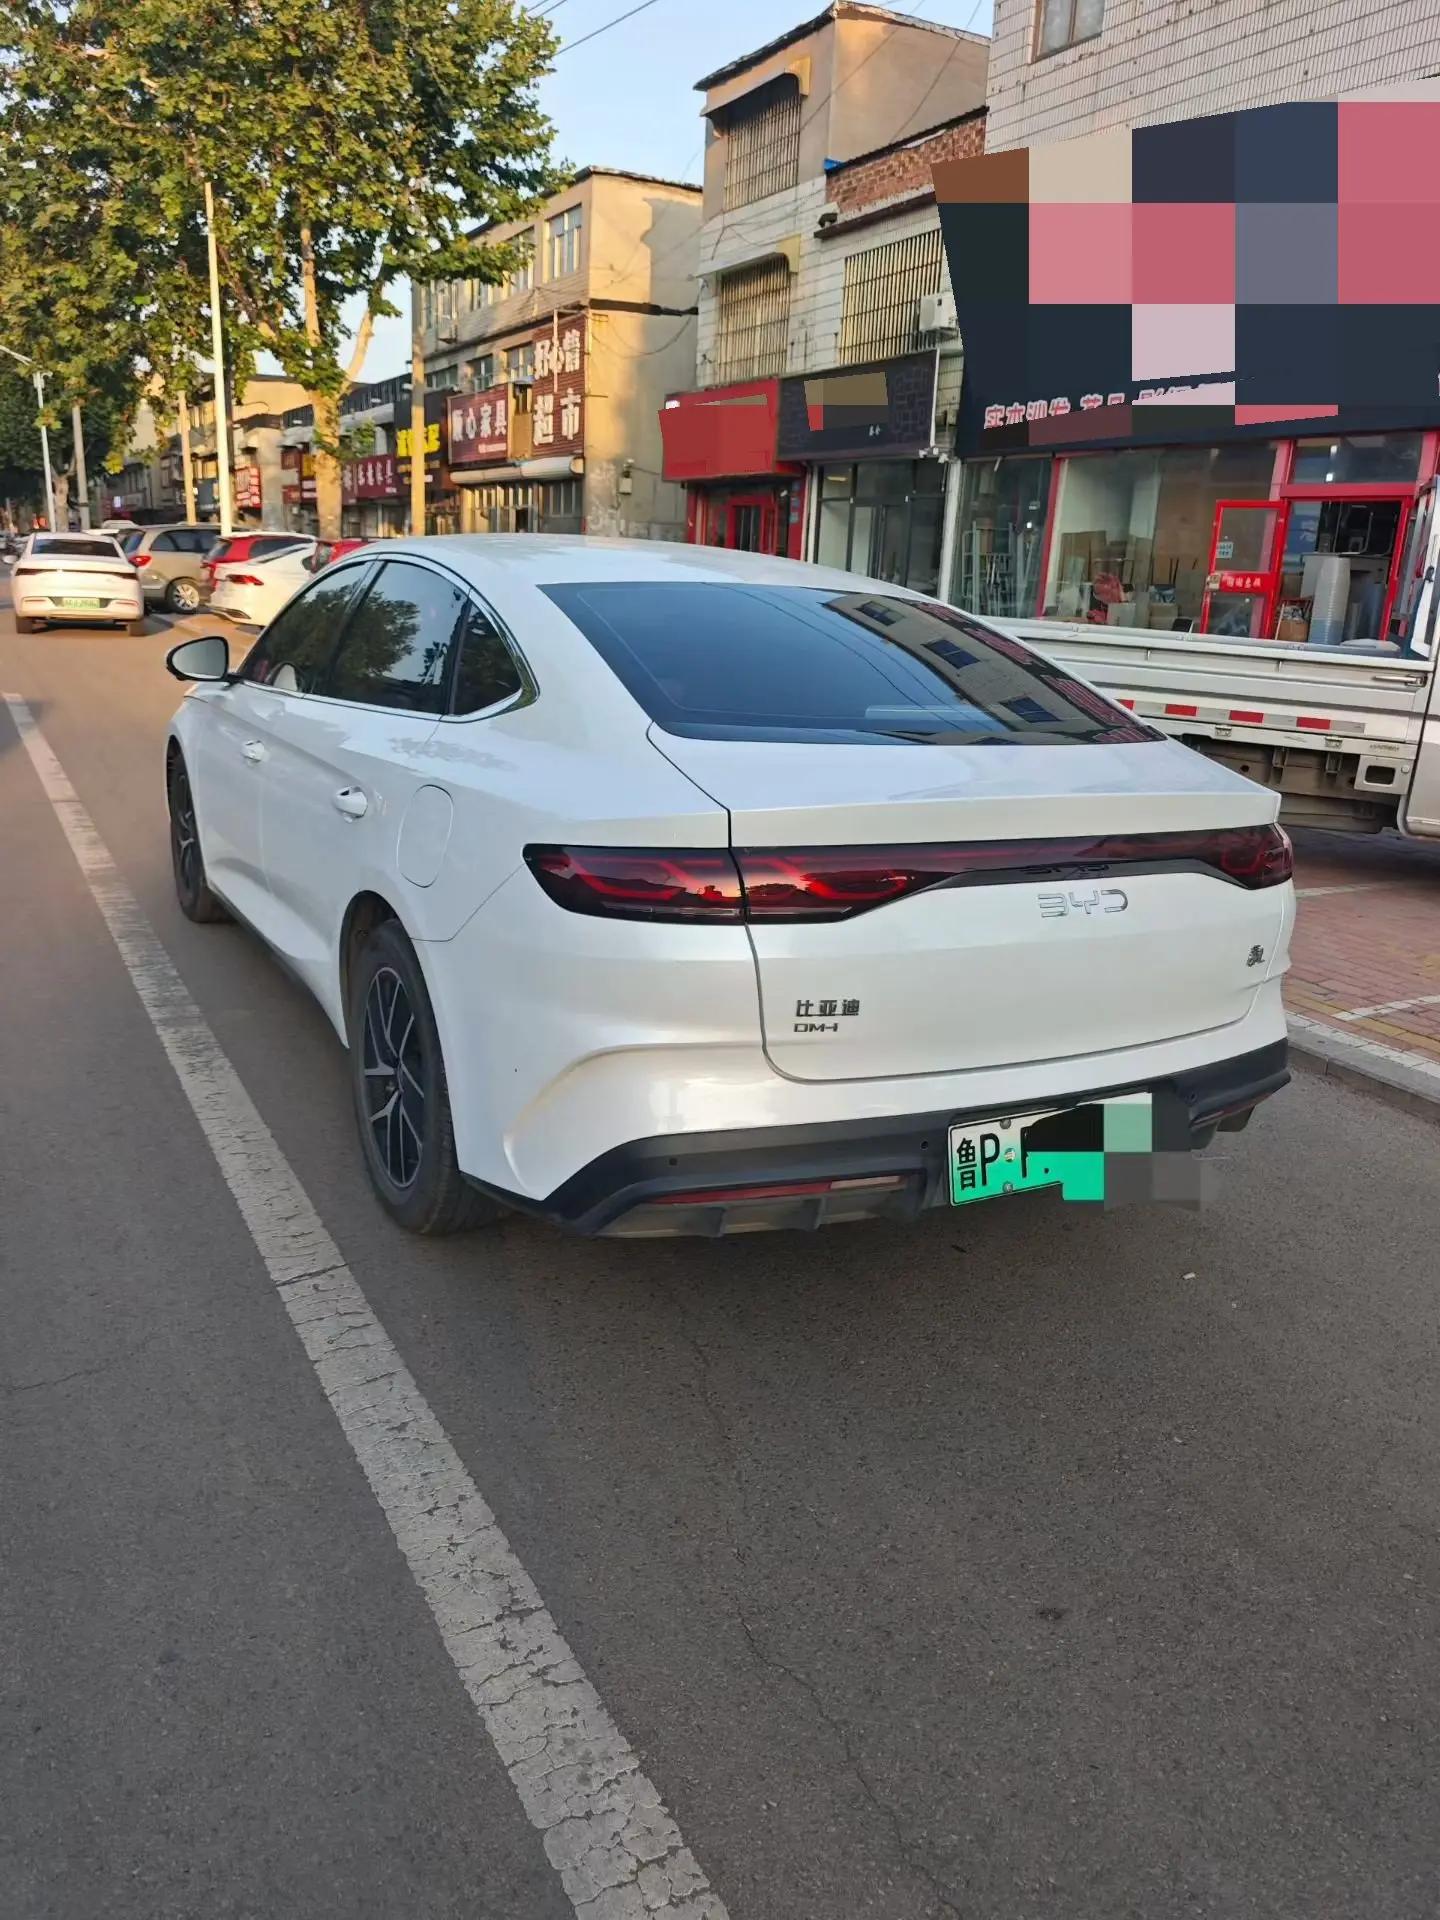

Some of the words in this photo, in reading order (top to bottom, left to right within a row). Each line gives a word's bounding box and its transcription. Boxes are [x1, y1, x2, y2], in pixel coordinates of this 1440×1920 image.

[533, 388, 582, 446] 超市
[1038, 889, 1128, 918] BYD
[796, 998, 861, 1018] 比亚迪
